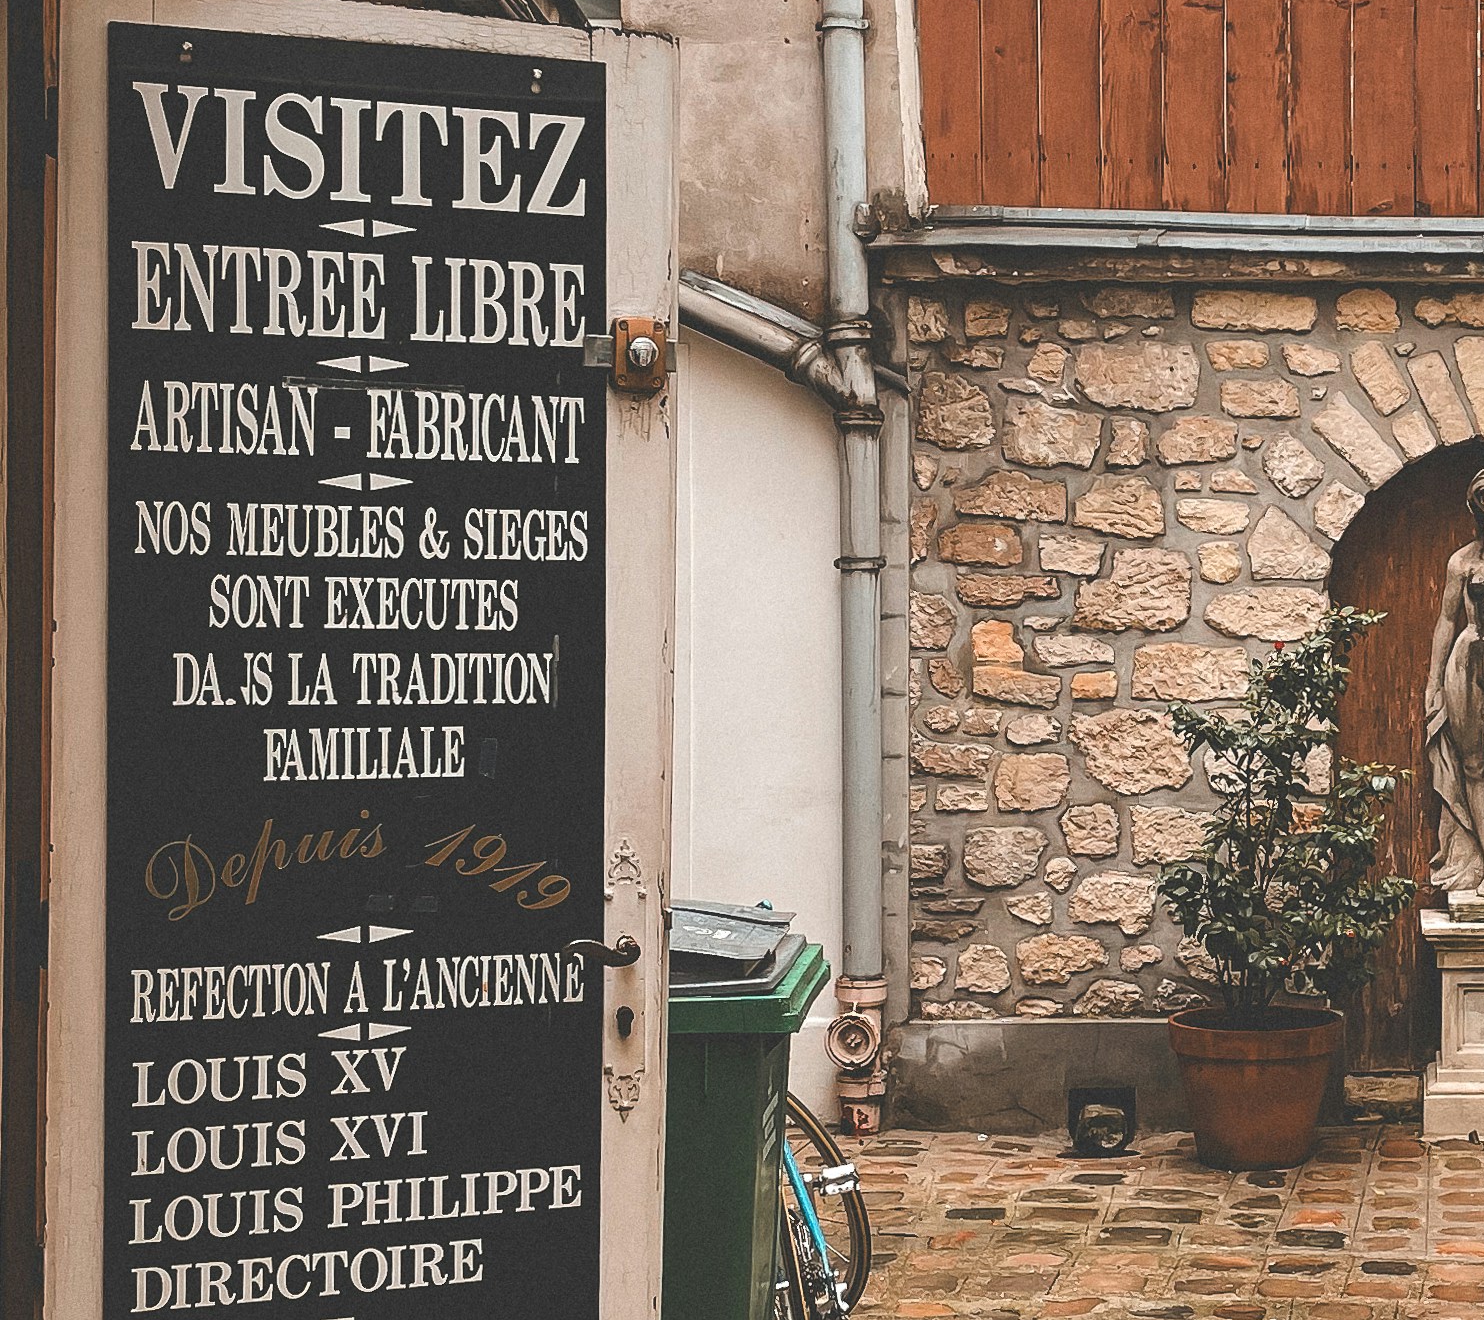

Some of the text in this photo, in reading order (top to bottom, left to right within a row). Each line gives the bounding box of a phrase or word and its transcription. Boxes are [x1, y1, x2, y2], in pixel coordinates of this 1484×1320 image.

[132, 81, 586, 217] VISITEZ
[131, 240, 585, 348] ENTREE LIBRE
[130, 380, 586, 465] ARTISAN - FABRICANT
[134, 500, 589, 562] NOS MEUBLES & SIEGES
[208, 573, 519, 632] SONT EXECUTES
[287, 652, 338, 706] LA
[352, 652, 554, 706] TRADITION
[262, 725, 466, 782] FAMILIALE
[144, 808, 572, 922] Depuis 1919
[129, 952, 585, 1023] REFECTION A L'ANCIENNE
[131, 1046, 407, 1108] LOUIS XV
[130, 1111, 429, 1177] LOUIS XVI
[127, 1164, 583, 1245] LOUIS PHILIPPE
[130, 1238, 484, 1313] DIRECTOIRE
